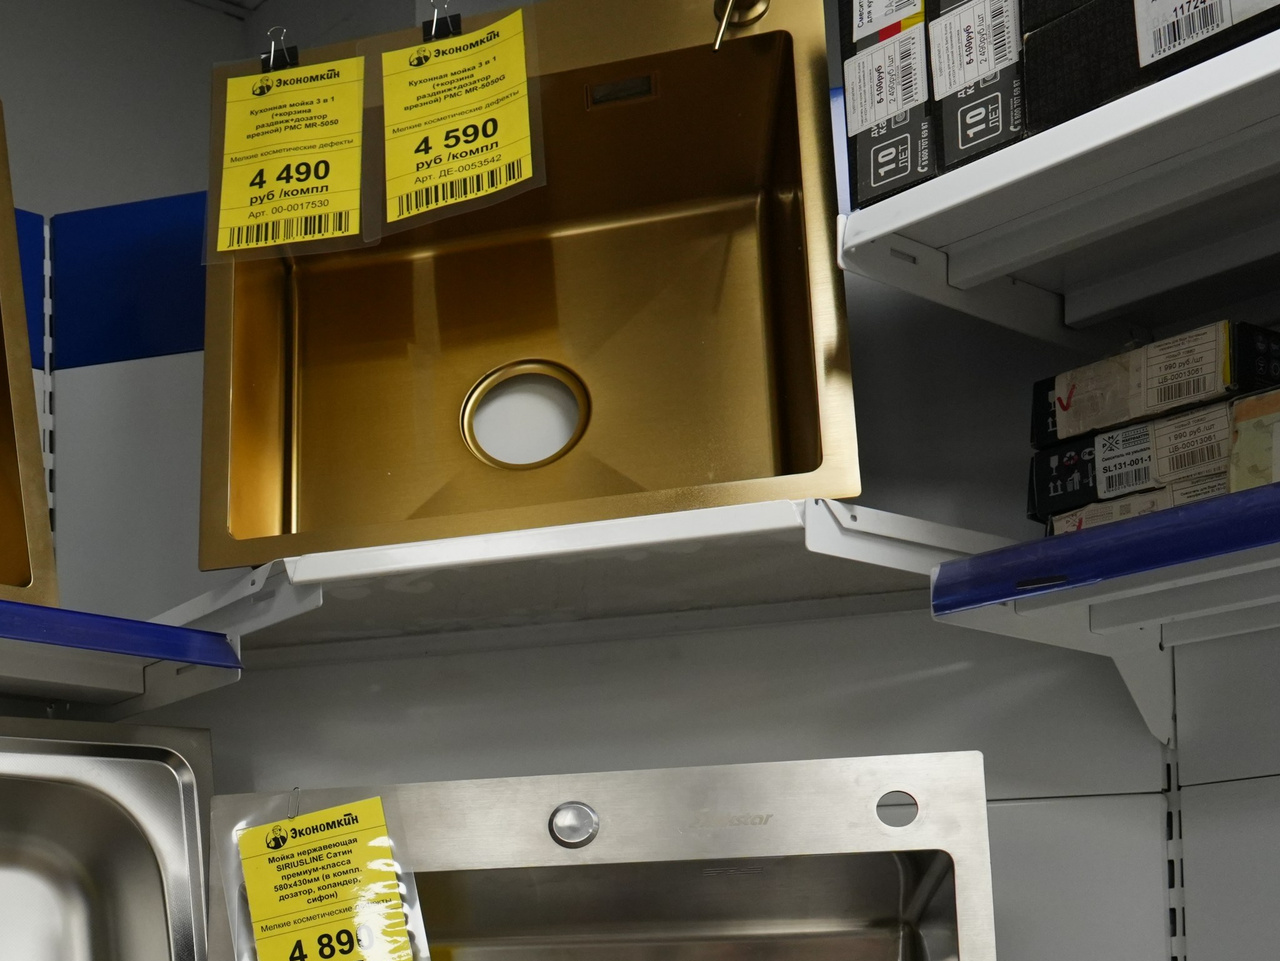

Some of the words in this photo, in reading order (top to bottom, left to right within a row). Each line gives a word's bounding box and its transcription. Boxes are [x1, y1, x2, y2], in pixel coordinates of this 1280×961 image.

[856, 0, 865, 28] Смесит
[965, 107, 987, 138] 10
[989, 104, 1000, 126] ЛЕТ
[413, 135, 432, 154] 4
[443, 117, 498, 148] 590
[414, 174, 435, 184] Арт.
[438, 153, 501, 179] ДЕ-0053542
[415, 154, 442, 171] руб
[446, 140, 498, 161] /компл
[877, 147, 897, 177] 10
[898, 143, 909, 168] ЛЕТ
[248, 168, 266, 189] 4
[275, 159, 330, 183] 490
[249, 189, 274, 206] руб
[278, 184, 328, 198] /компл
[247, 210, 267, 219] Арт.
[270, 198, 329, 214] 00-0017530
[1102, 455, 1152, 473] SL131-001-1
[267, 853, 294, 864] Мойка
[296, 837, 357, 857] нержавеющая
[276, 853, 324, 871] SIRIUSLINE
[325, 848, 352, 859] Сатин
[280, 858, 351, 880] премиум-класса
[306, 890, 338, 904] сифон)
